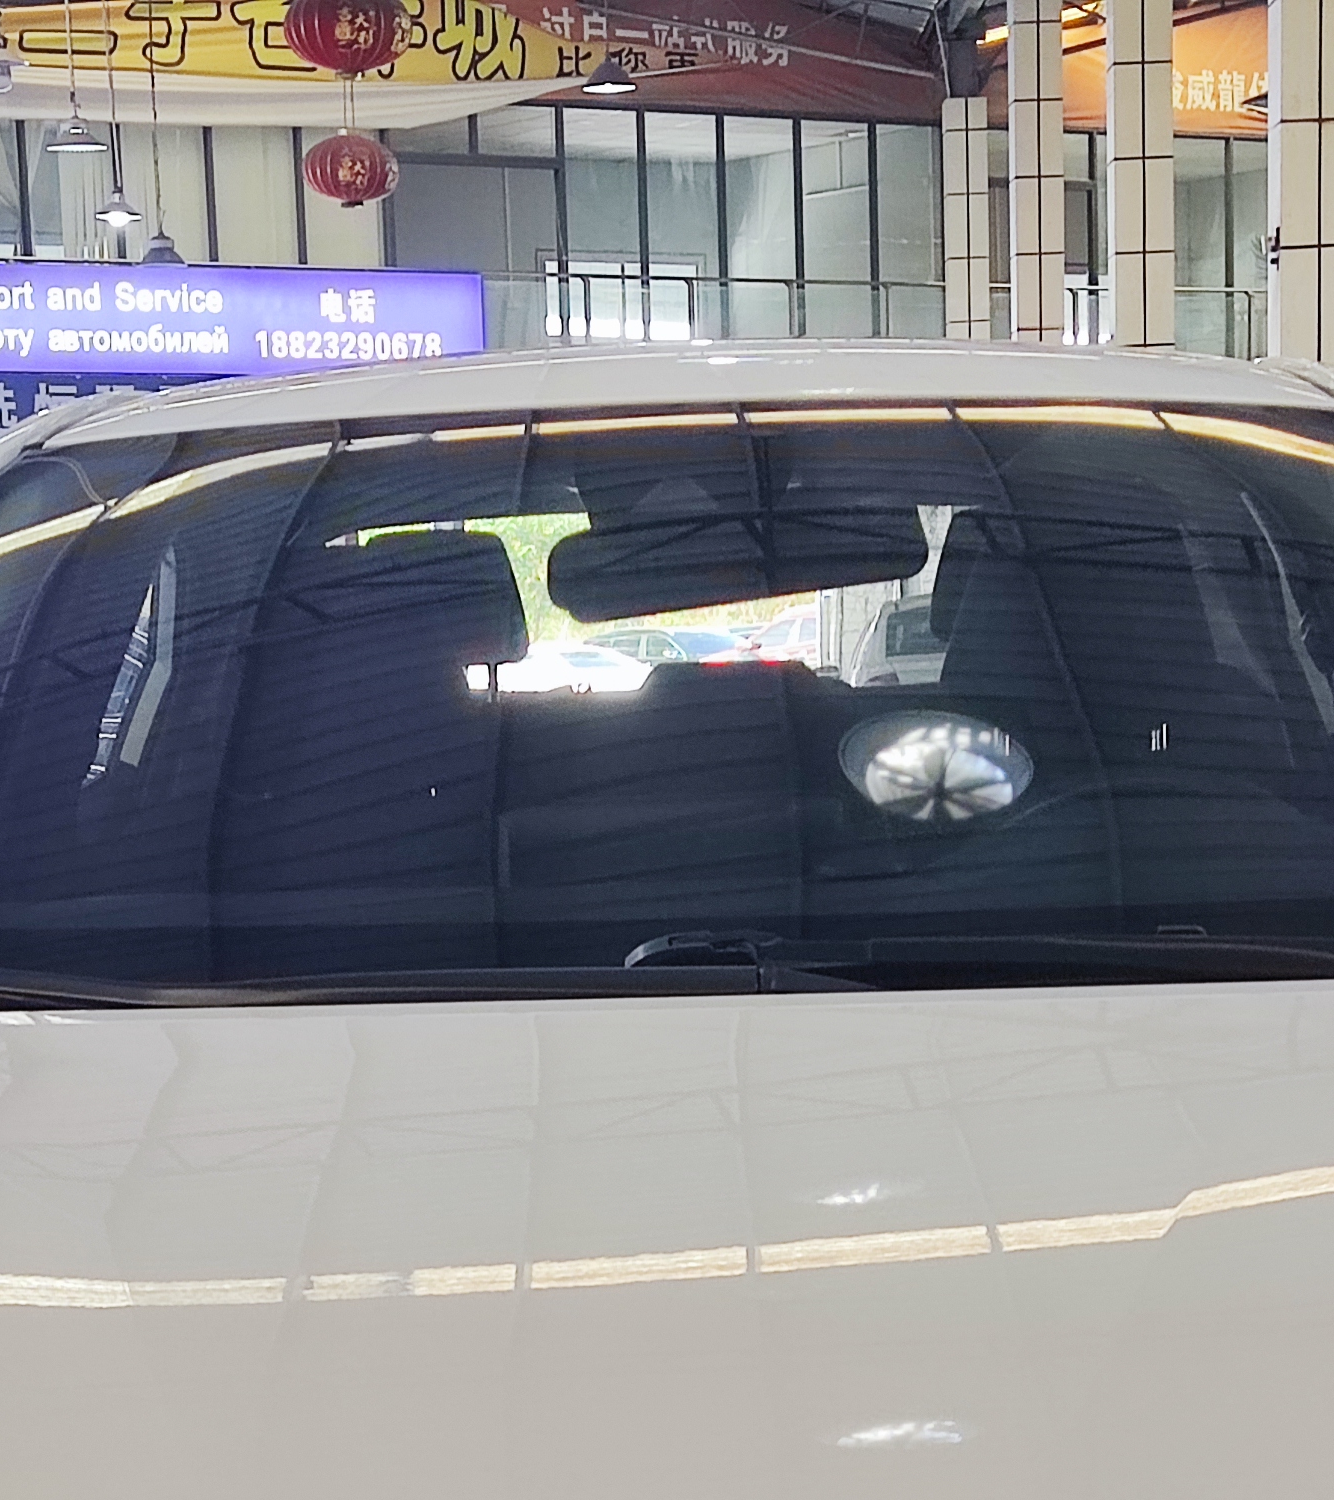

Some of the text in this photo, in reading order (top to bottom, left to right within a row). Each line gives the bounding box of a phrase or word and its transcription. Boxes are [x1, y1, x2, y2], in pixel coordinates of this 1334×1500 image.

[47, 281, 101, 311] and
[115, 281, 224, 314] Service
[319, 288, 376, 323] 电话
[48, 323, 229, 354] автомобилей
[255, 330, 442, 360] 18823290678
